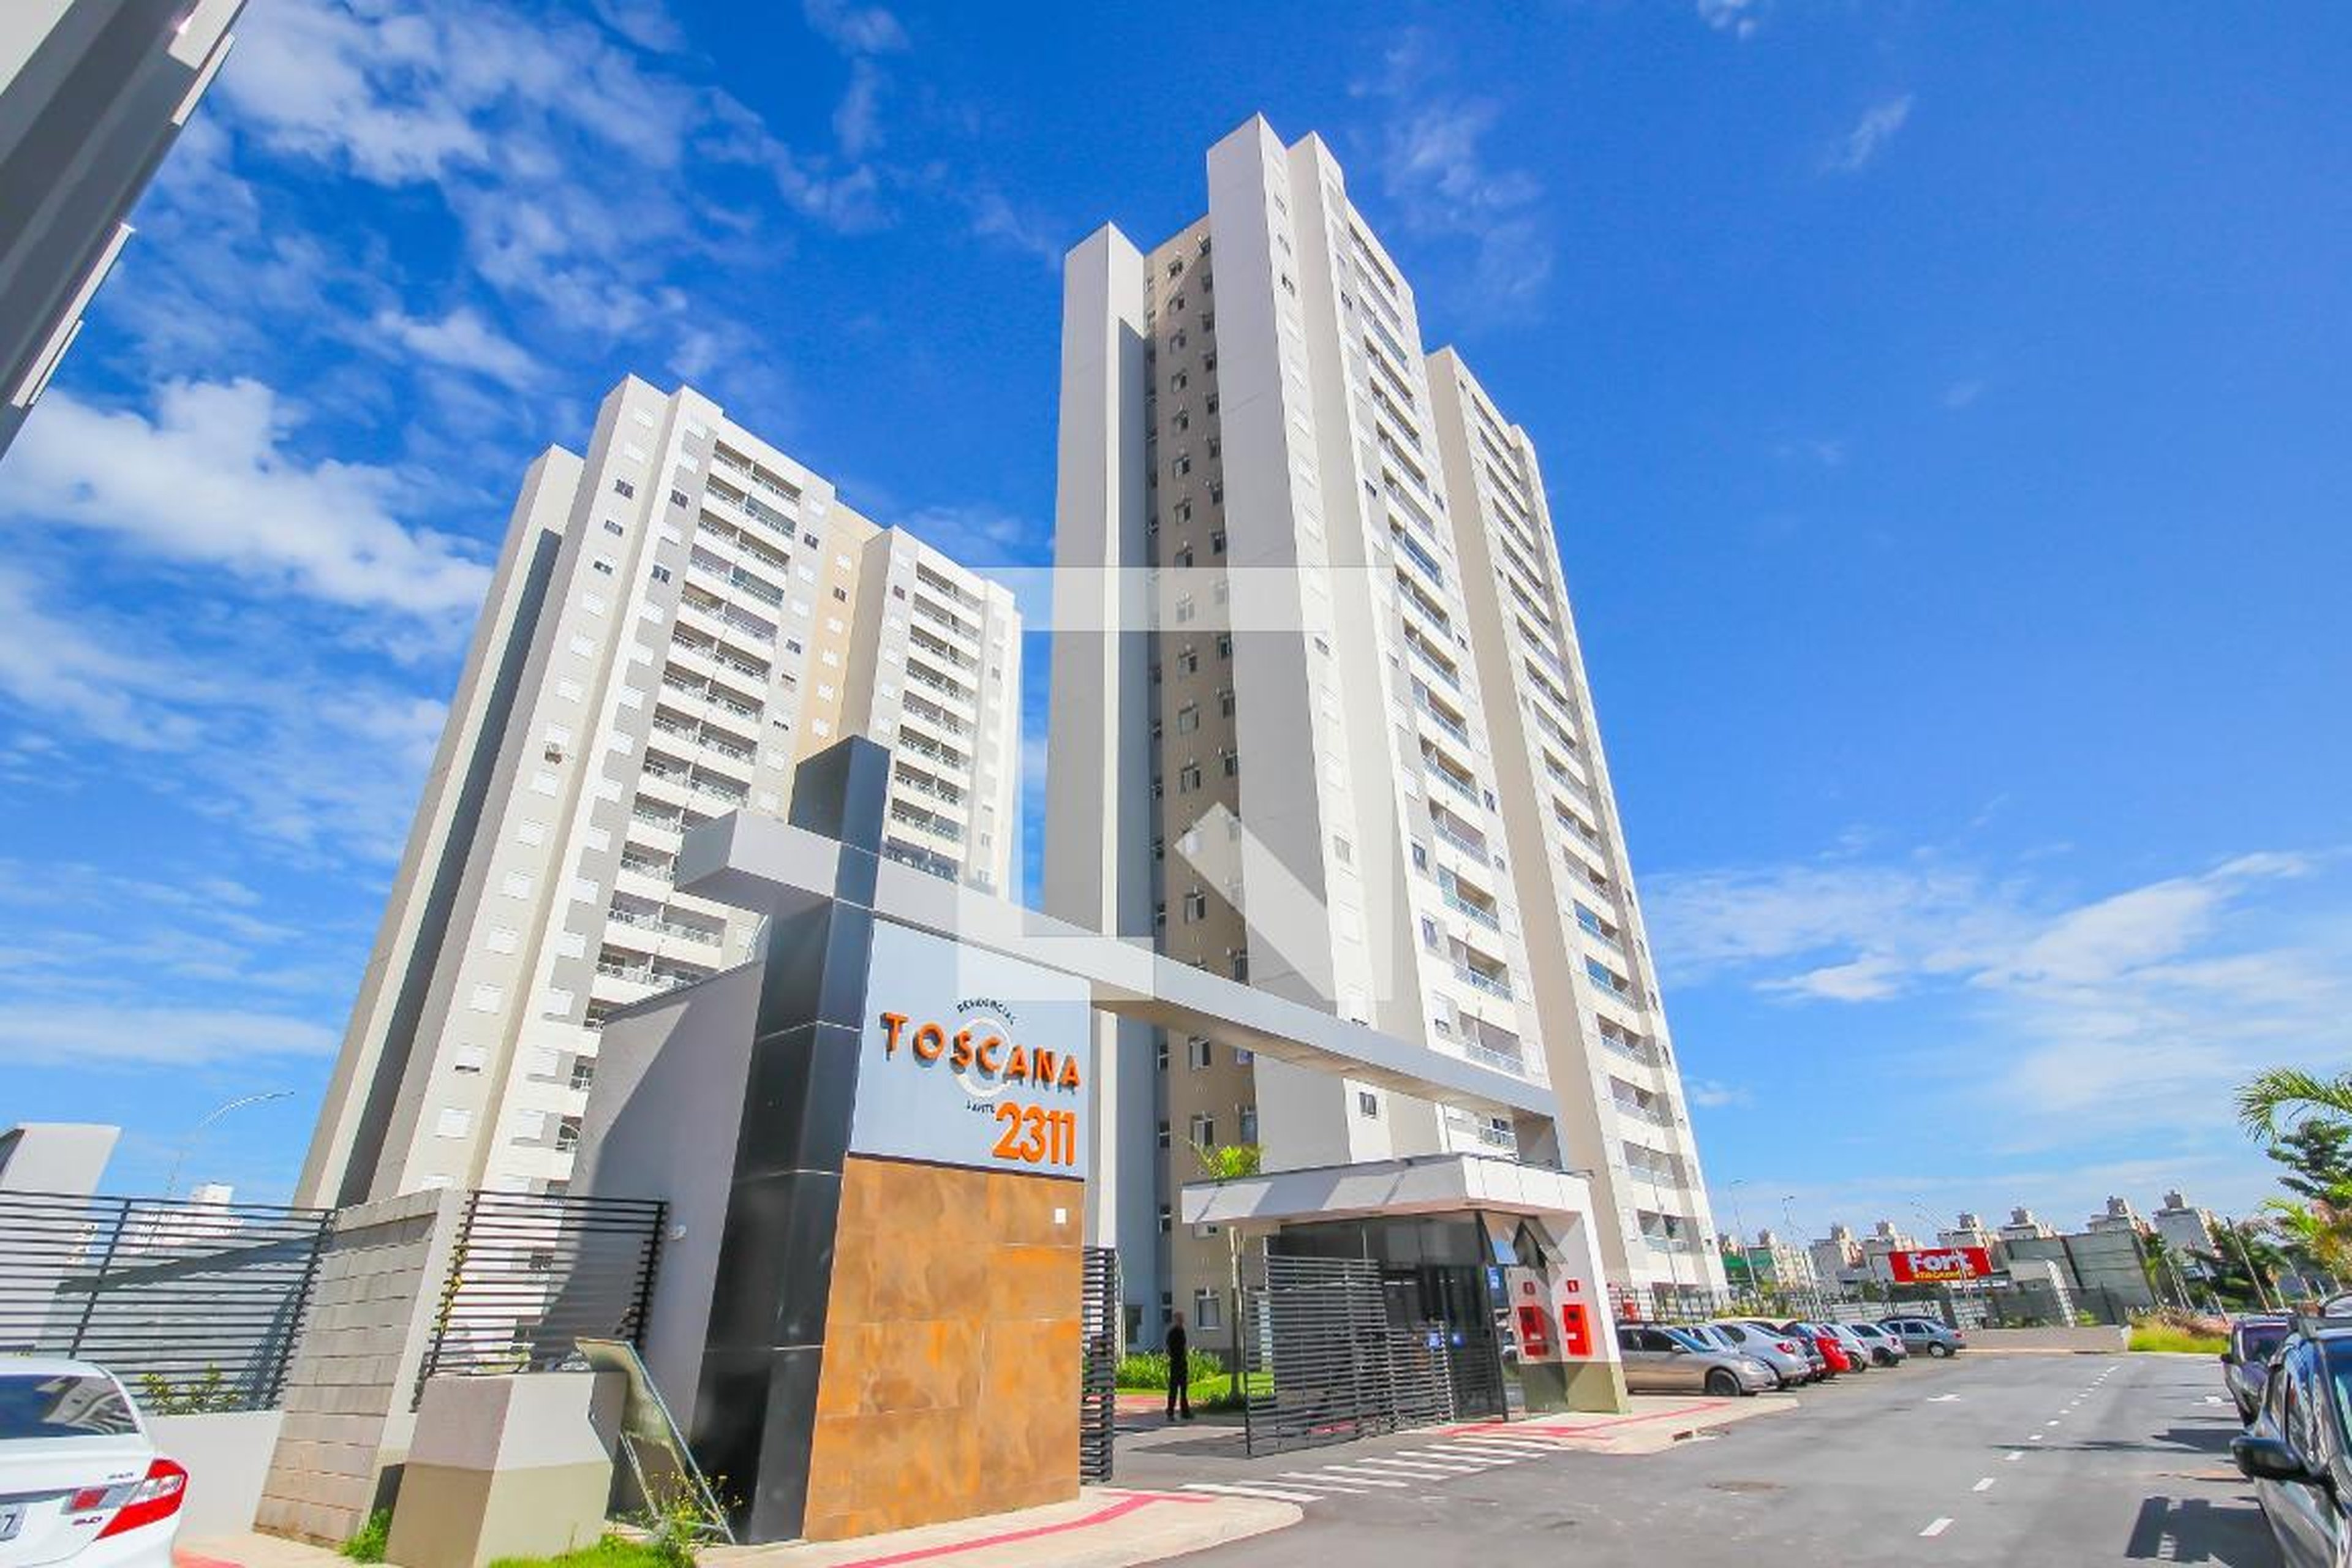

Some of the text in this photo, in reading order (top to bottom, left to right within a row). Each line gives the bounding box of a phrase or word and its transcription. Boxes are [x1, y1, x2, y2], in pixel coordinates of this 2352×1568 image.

[880, 1012, 1080, 1088] TOSCANA
[992, 1102, 1076, 1166] 2311
[1908, 1253, 1973, 1273] Fort
